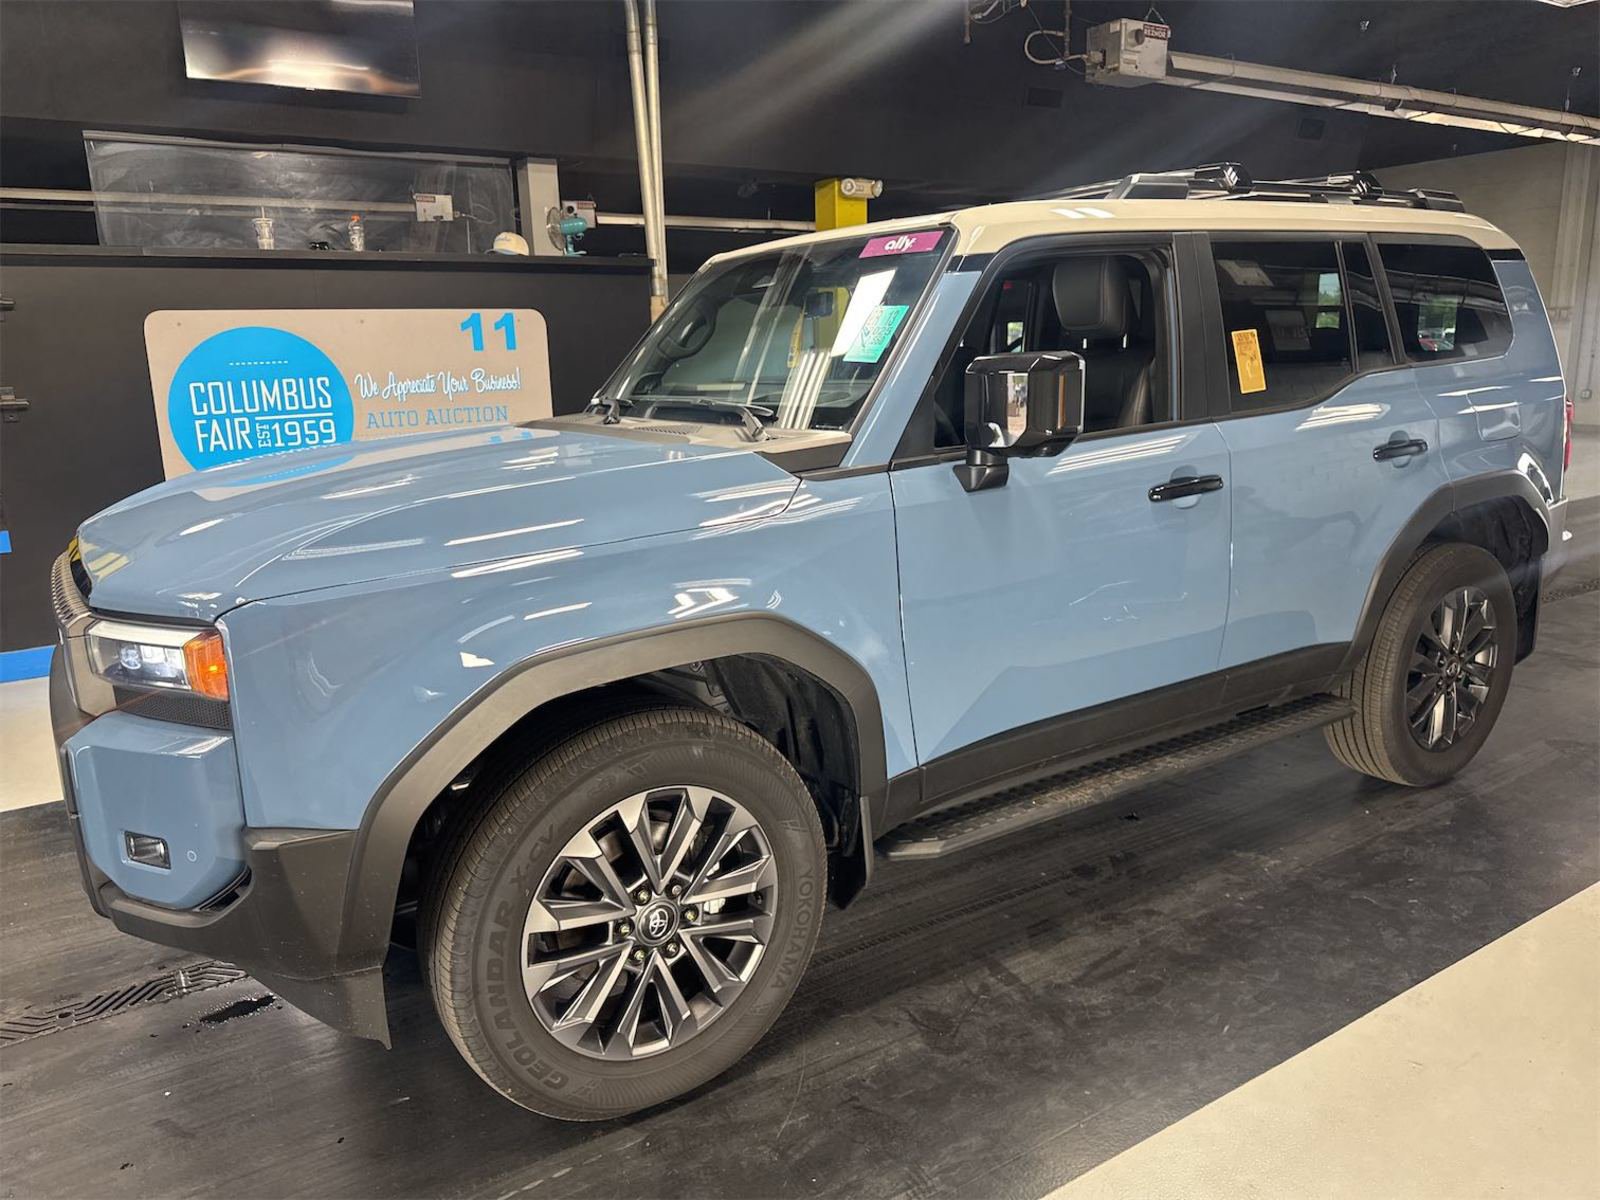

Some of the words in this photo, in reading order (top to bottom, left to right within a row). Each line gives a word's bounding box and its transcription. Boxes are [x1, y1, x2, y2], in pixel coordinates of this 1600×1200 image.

[885, 235, 917, 252] ally
[460, 312, 517, 352] 11
[188, 376, 333, 416] COLUMBUS
[354, 372, 380, 399] We
[382, 371, 437, 403] Appreciate
[438, 371, 469, 401] Your
[471, 368, 521, 393] Business!
[194, 417, 254, 453] FAIR
[271, 419, 337, 448] 1959
[367, 409, 420, 429] AUTO
[425, 405, 509, 426] AUCTION
[771, 867, 814, 989] YOKOHAMA
[486, 900, 569, 1091] GEOLANDAR
